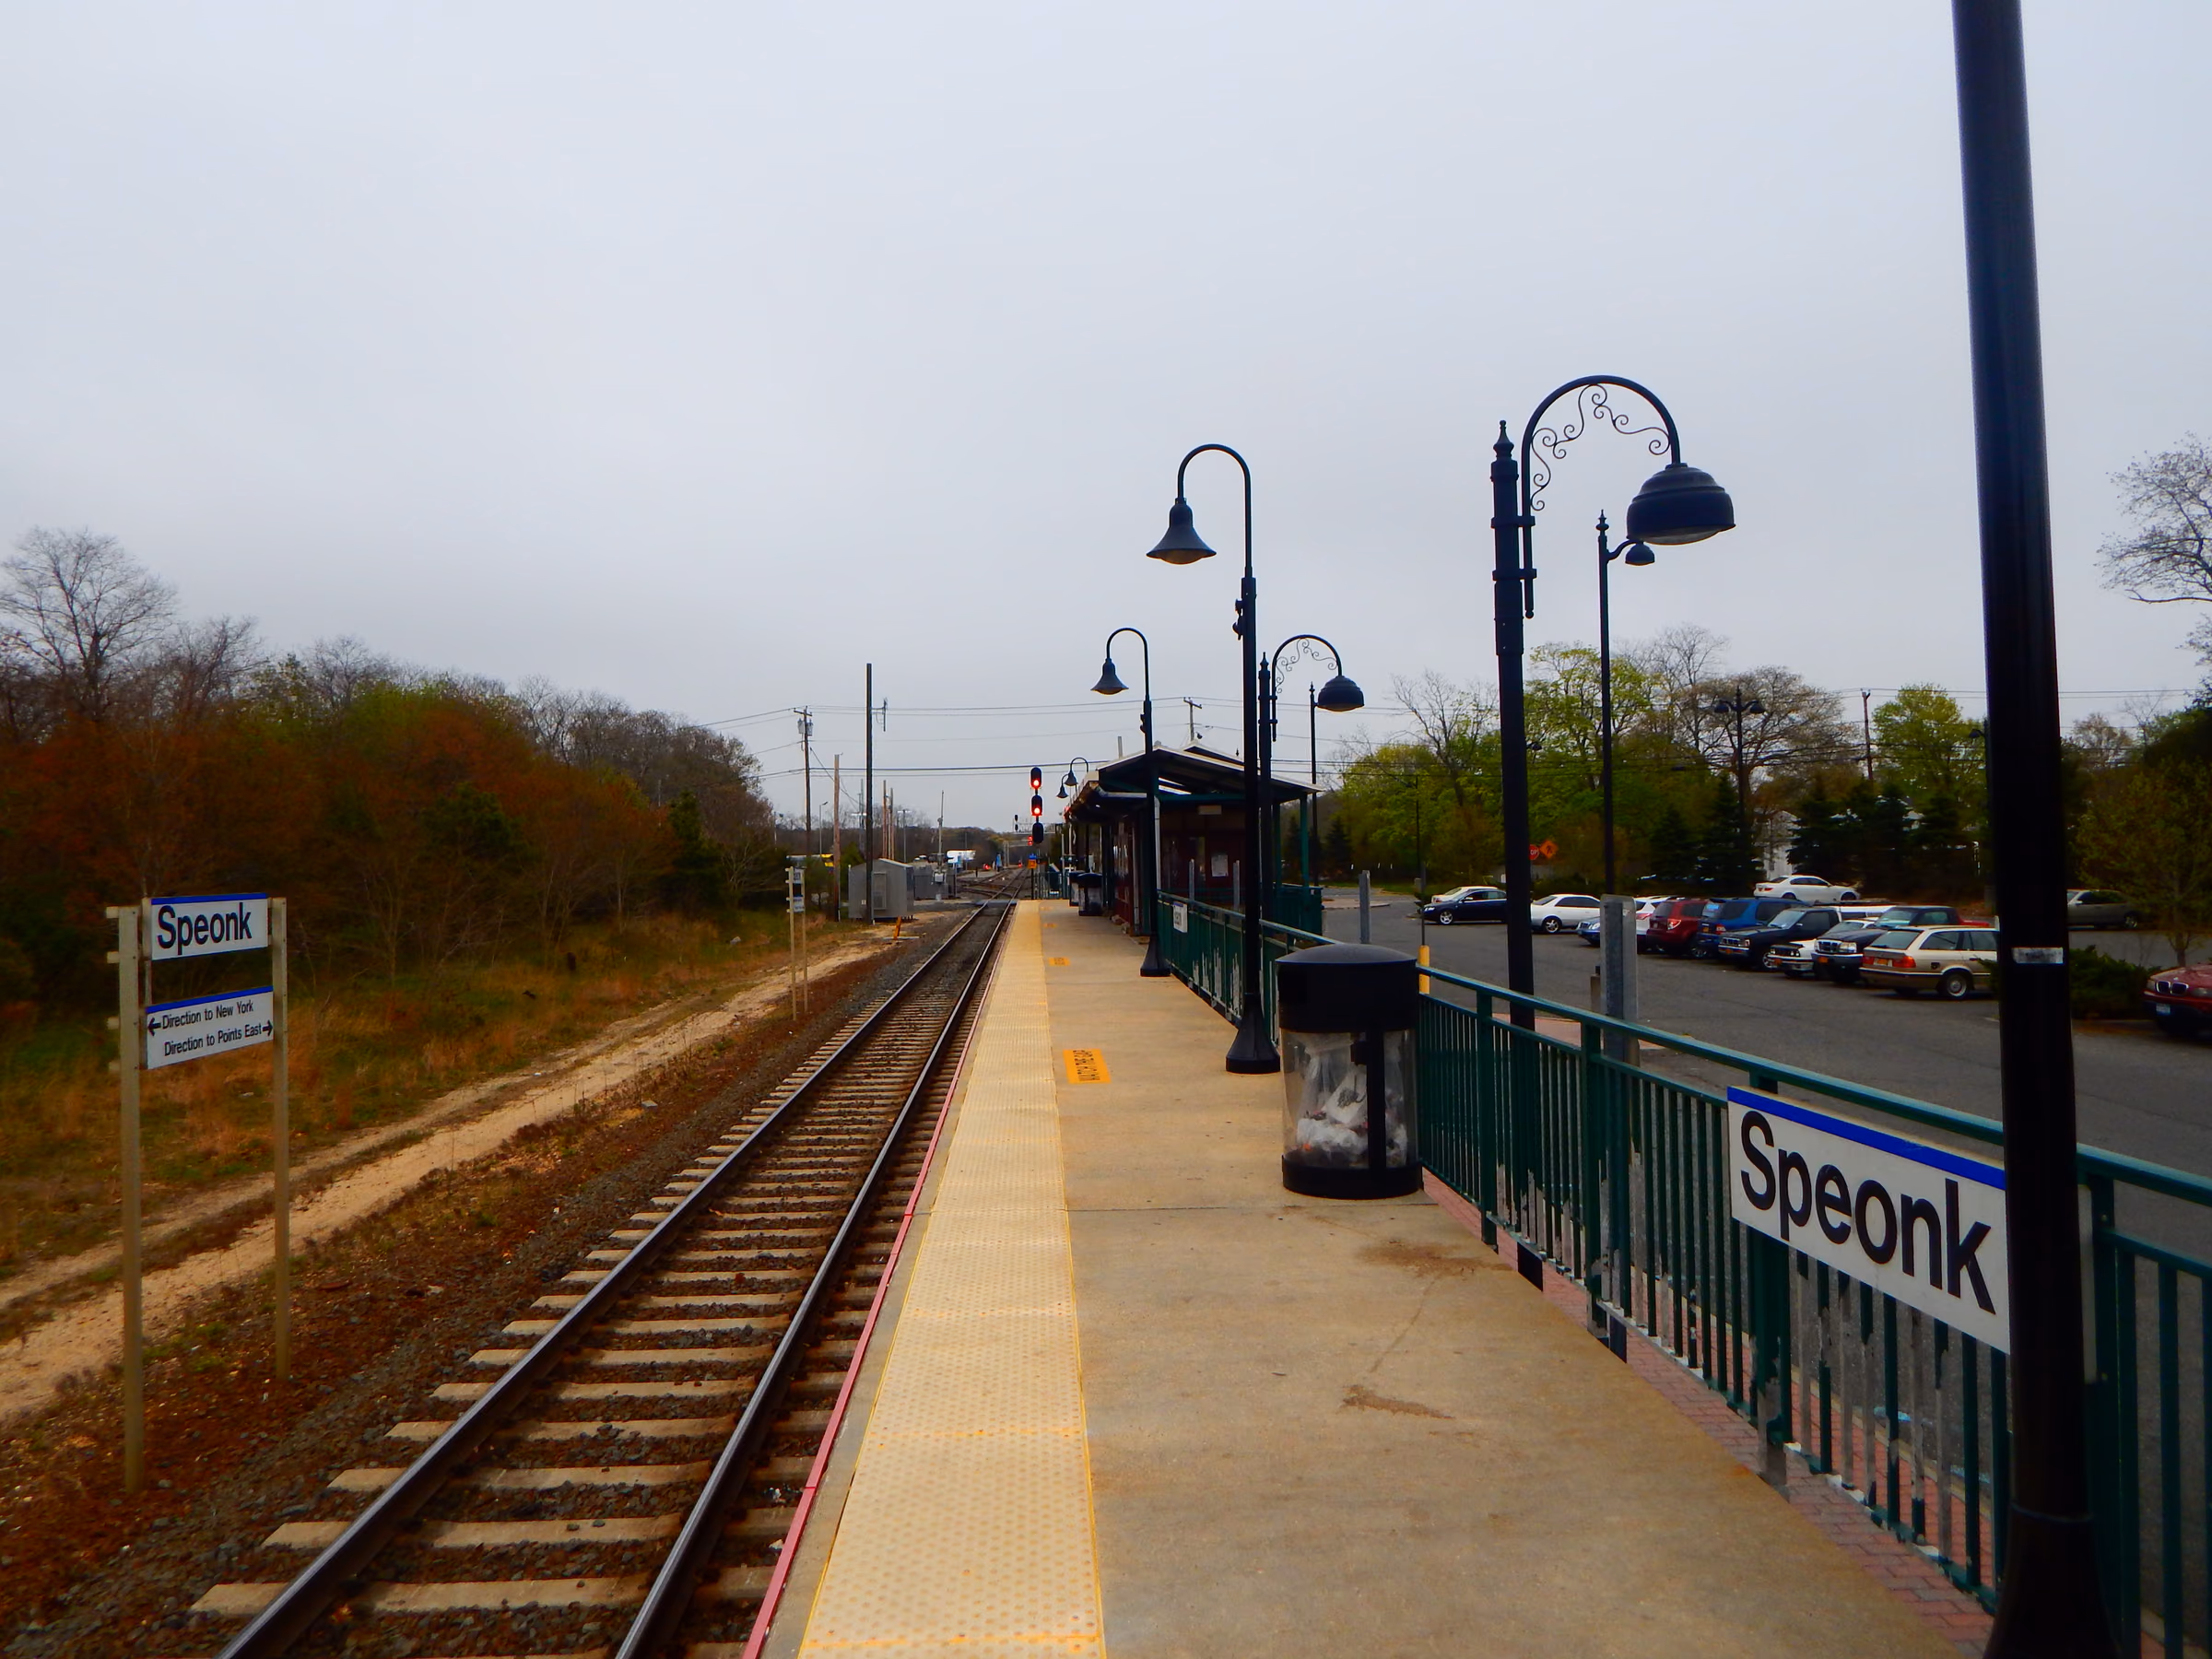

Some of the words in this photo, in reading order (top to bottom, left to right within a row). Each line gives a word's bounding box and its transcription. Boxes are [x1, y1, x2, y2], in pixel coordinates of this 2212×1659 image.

[157, 902, 252, 955] Speonk
[162, 1011, 202, 1030] Direction
[205, 1008, 213, 1021] to
[217, 1005, 233, 1019] New
[237, 999, 253, 1015] York
[164, 1037, 204, 1056] Direction
[206, 1034, 215, 1047] to
[218, 1028, 242, 1044] Points
[244, 1023, 262, 1038] East
[1740, 1110, 1996, 1315] Speonk
